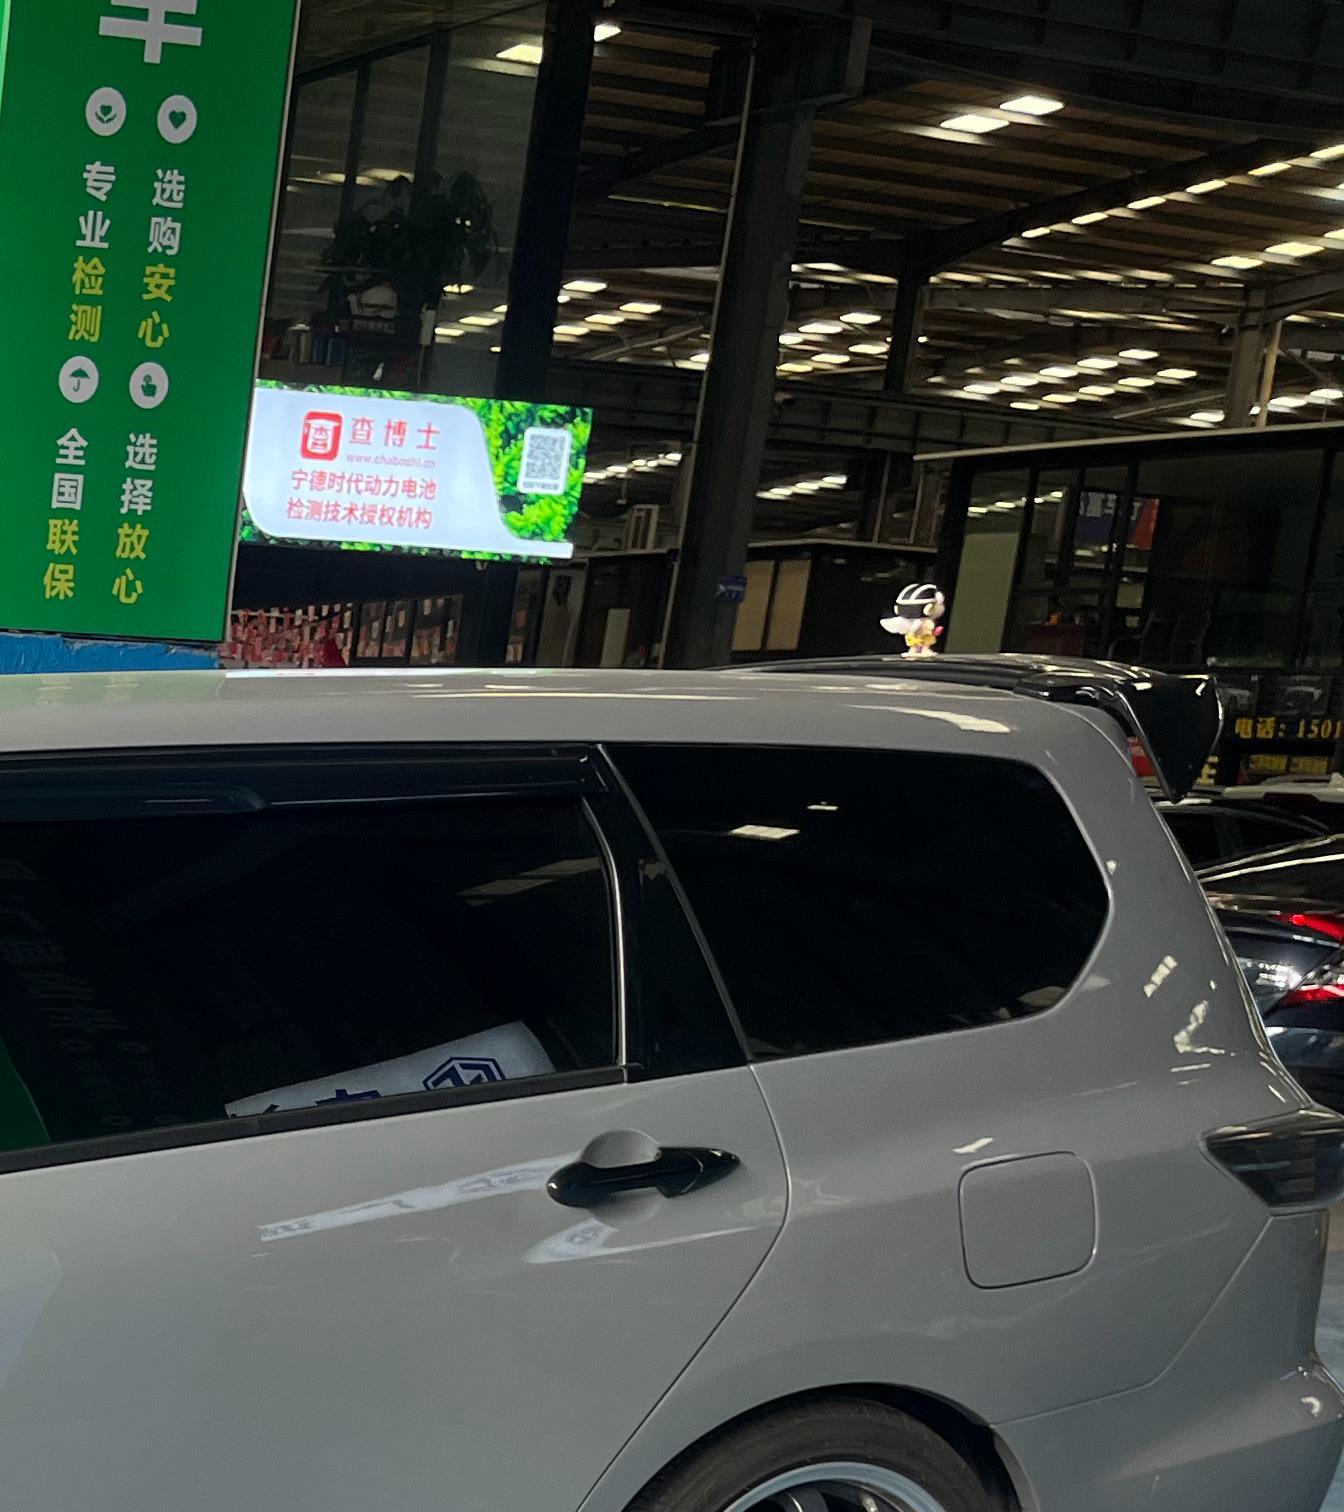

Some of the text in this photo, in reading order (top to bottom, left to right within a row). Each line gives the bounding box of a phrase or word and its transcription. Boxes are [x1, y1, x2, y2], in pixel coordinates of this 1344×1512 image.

[68, 161, 117, 343] 专业检测
[138, 168, 186, 348] 选购安心
[43, 428, 88, 600] 全国联保
[112, 433, 158, 604] 选择放心
[287, 496, 433, 530] 检测技术授权机构
[290, 468, 437, 501] 宁德时代动力电池
[348, 416, 440, 451] 查博士
